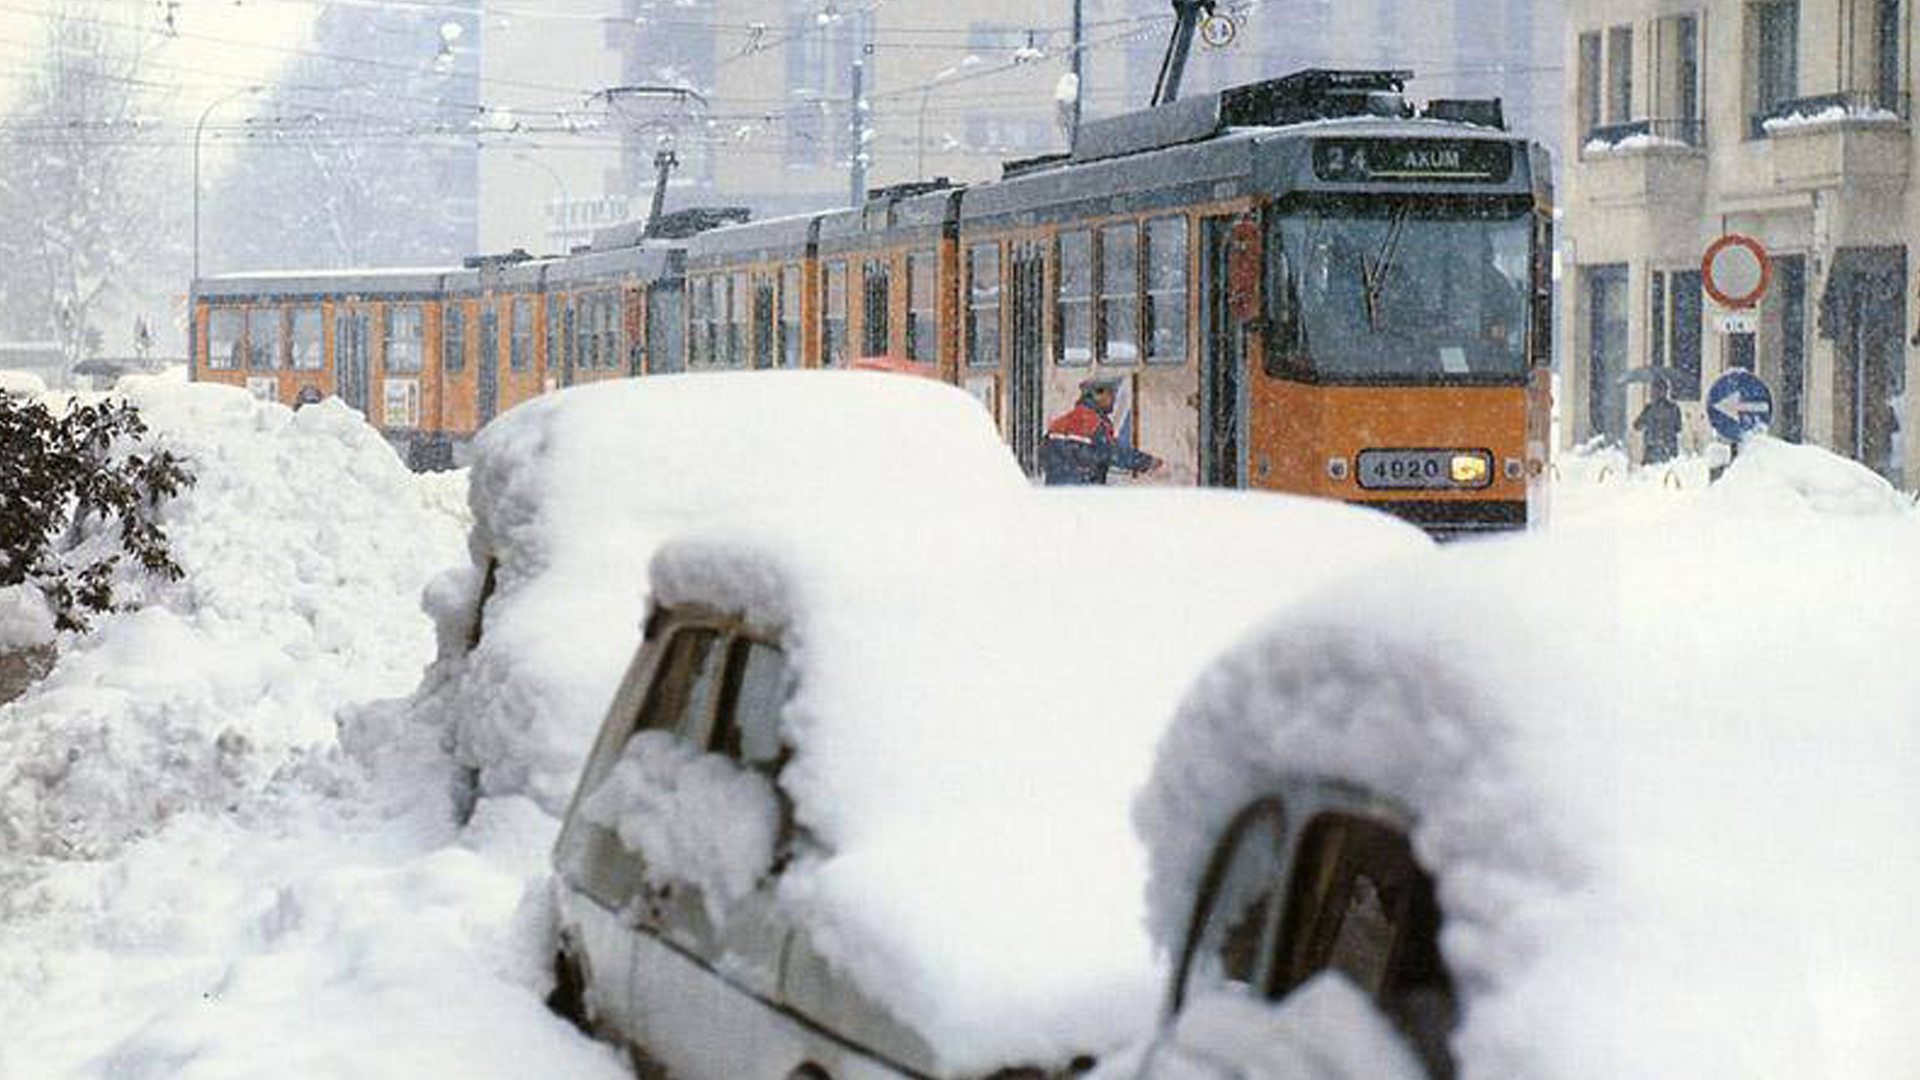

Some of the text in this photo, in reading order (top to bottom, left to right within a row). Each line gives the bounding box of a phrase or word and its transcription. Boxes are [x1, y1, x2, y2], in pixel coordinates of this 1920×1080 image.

[1328, 147, 1460, 171] 24 AXUM
[1374, 459, 1439, 479] 4920
